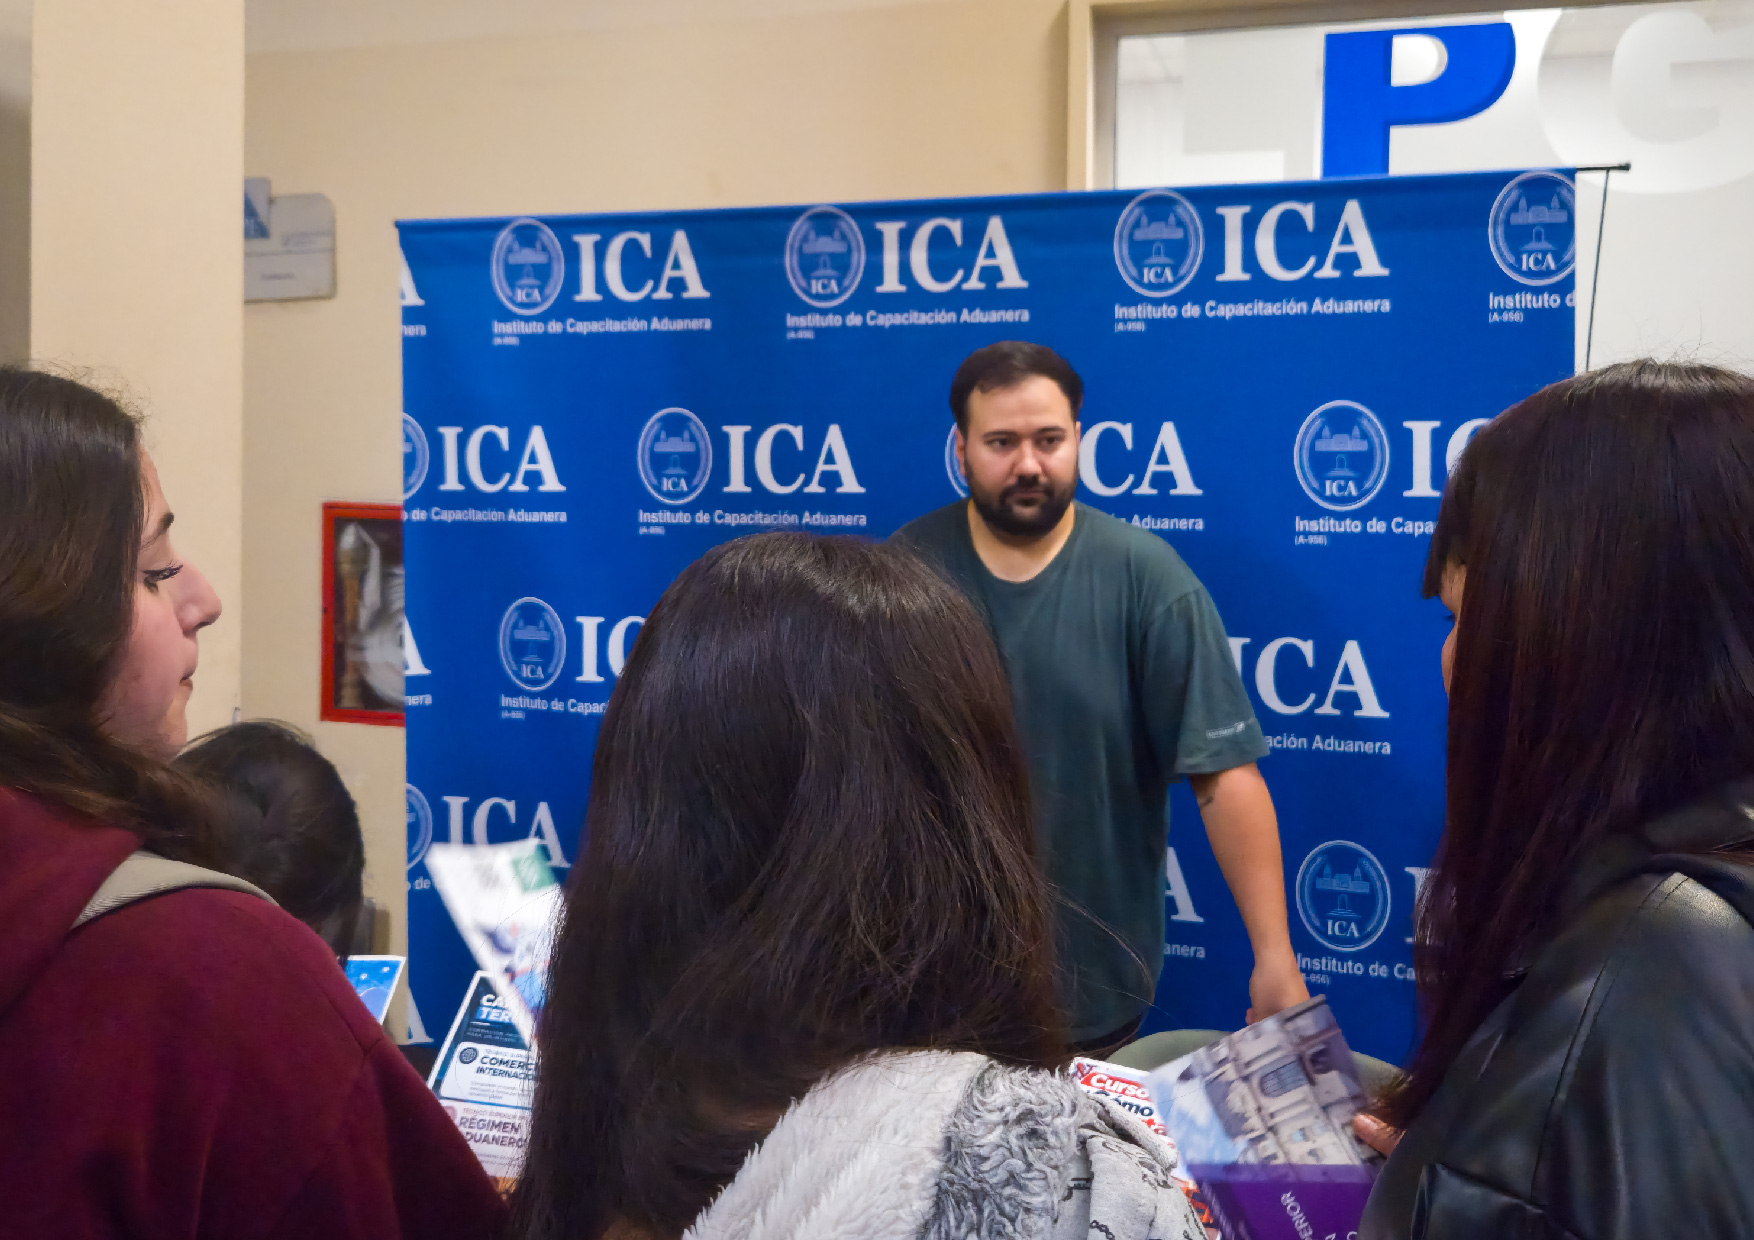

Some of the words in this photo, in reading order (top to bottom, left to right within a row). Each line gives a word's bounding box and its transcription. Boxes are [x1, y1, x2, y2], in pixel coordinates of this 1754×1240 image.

[1216, 199, 1390, 282] ICA
[875, 216, 1029, 293] ICA
[1521, 252, 1556, 272] ICA
[573, 229, 711, 302] ICA
[1143, 266, 1174, 284] ICA
[516, 287, 542, 303] ICA
[810, 278, 839, 295] ICA
[1115, 302, 1178, 320] Instituto
[1181, 301, 1201, 318] de
[1205, 298, 1308, 321] Capacitación
[1311, 297, 1391, 315] Aduanera
[1489, 292, 1561, 309] Instituto
[493, 319, 545, 335] Instituto
[547, 319, 564, 334] de
[566, 316, 648, 335] Capacitación
[650, 316, 712, 332] Aduanera
[786, 312, 843, 328] Instituto
[845, 311, 864, 327] de
[866, 308, 958, 329] Capacitación
[959, 307, 1030, 324] Aduanera
[437, 424, 567, 493] ICA
[722, 423, 867, 494] ICA
[661, 477, 689, 493] ICA
[1325, 479, 1358, 497] ICA
[411, 507, 427, 522] de
[431, 507, 504, 523] Capacitación
[507, 508, 568, 523] Aduanera
[639, 509, 692, 524] Instituto
[695, 509, 711, 524] de
[713, 509, 800, 527] Capacitación
[802, 510, 867, 526] Aduanera
[1131, 514, 1204, 530] Aduanera
[1295, 516, 1362, 533] Instituto
[1366, 517, 1387, 533] de
[520, 664, 545, 680] ICA
[501, 693, 549, 710] Instituto
[551, 697, 565, 711] de
[1312, 734, 1391, 756] Aduanera
[414, 876, 432, 890] de
[1327, 919, 1360, 938] ICA
[1297, 952, 1364, 975] Instituto
[1369, 960, 1388, 977] de
[1090, 1073, 1150, 1098] Curso
[1280, 1190, 1314, 1240] ERIOR
